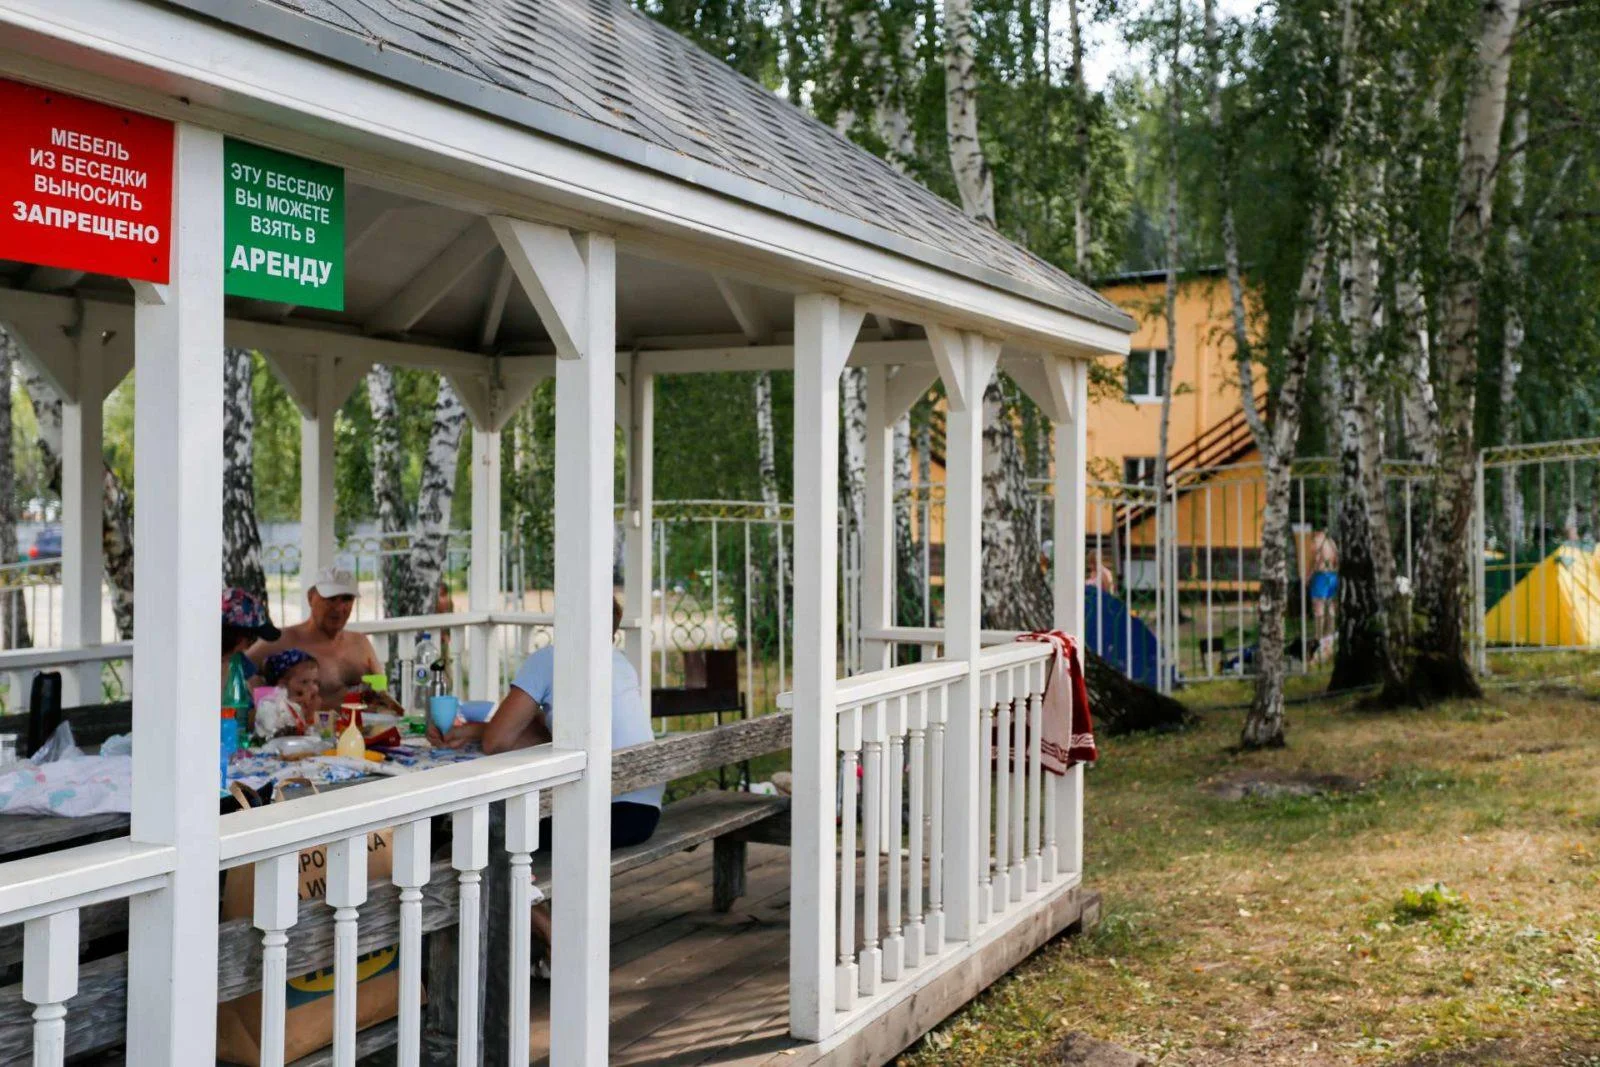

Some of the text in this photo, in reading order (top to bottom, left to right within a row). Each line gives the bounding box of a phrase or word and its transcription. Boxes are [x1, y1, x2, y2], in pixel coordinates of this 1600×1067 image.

[51, 127, 130, 161] МЕБЕЛЬ
[30, 147, 147, 189] ИЗ БЕСЕДКИ
[230, 162, 335, 203] ЭТУ БЕСЕДКУ
[34, 173, 143, 212] ВЫНОСИТЬ
[235, 187, 330, 225] ВЫ МОЖЕТЕ
[12, 200, 160, 245] ЗАПРЕЩЕНО
[250, 215, 316, 244] ВЗЯТЬ В
[230, 244, 334, 288] АРЕНДУ
